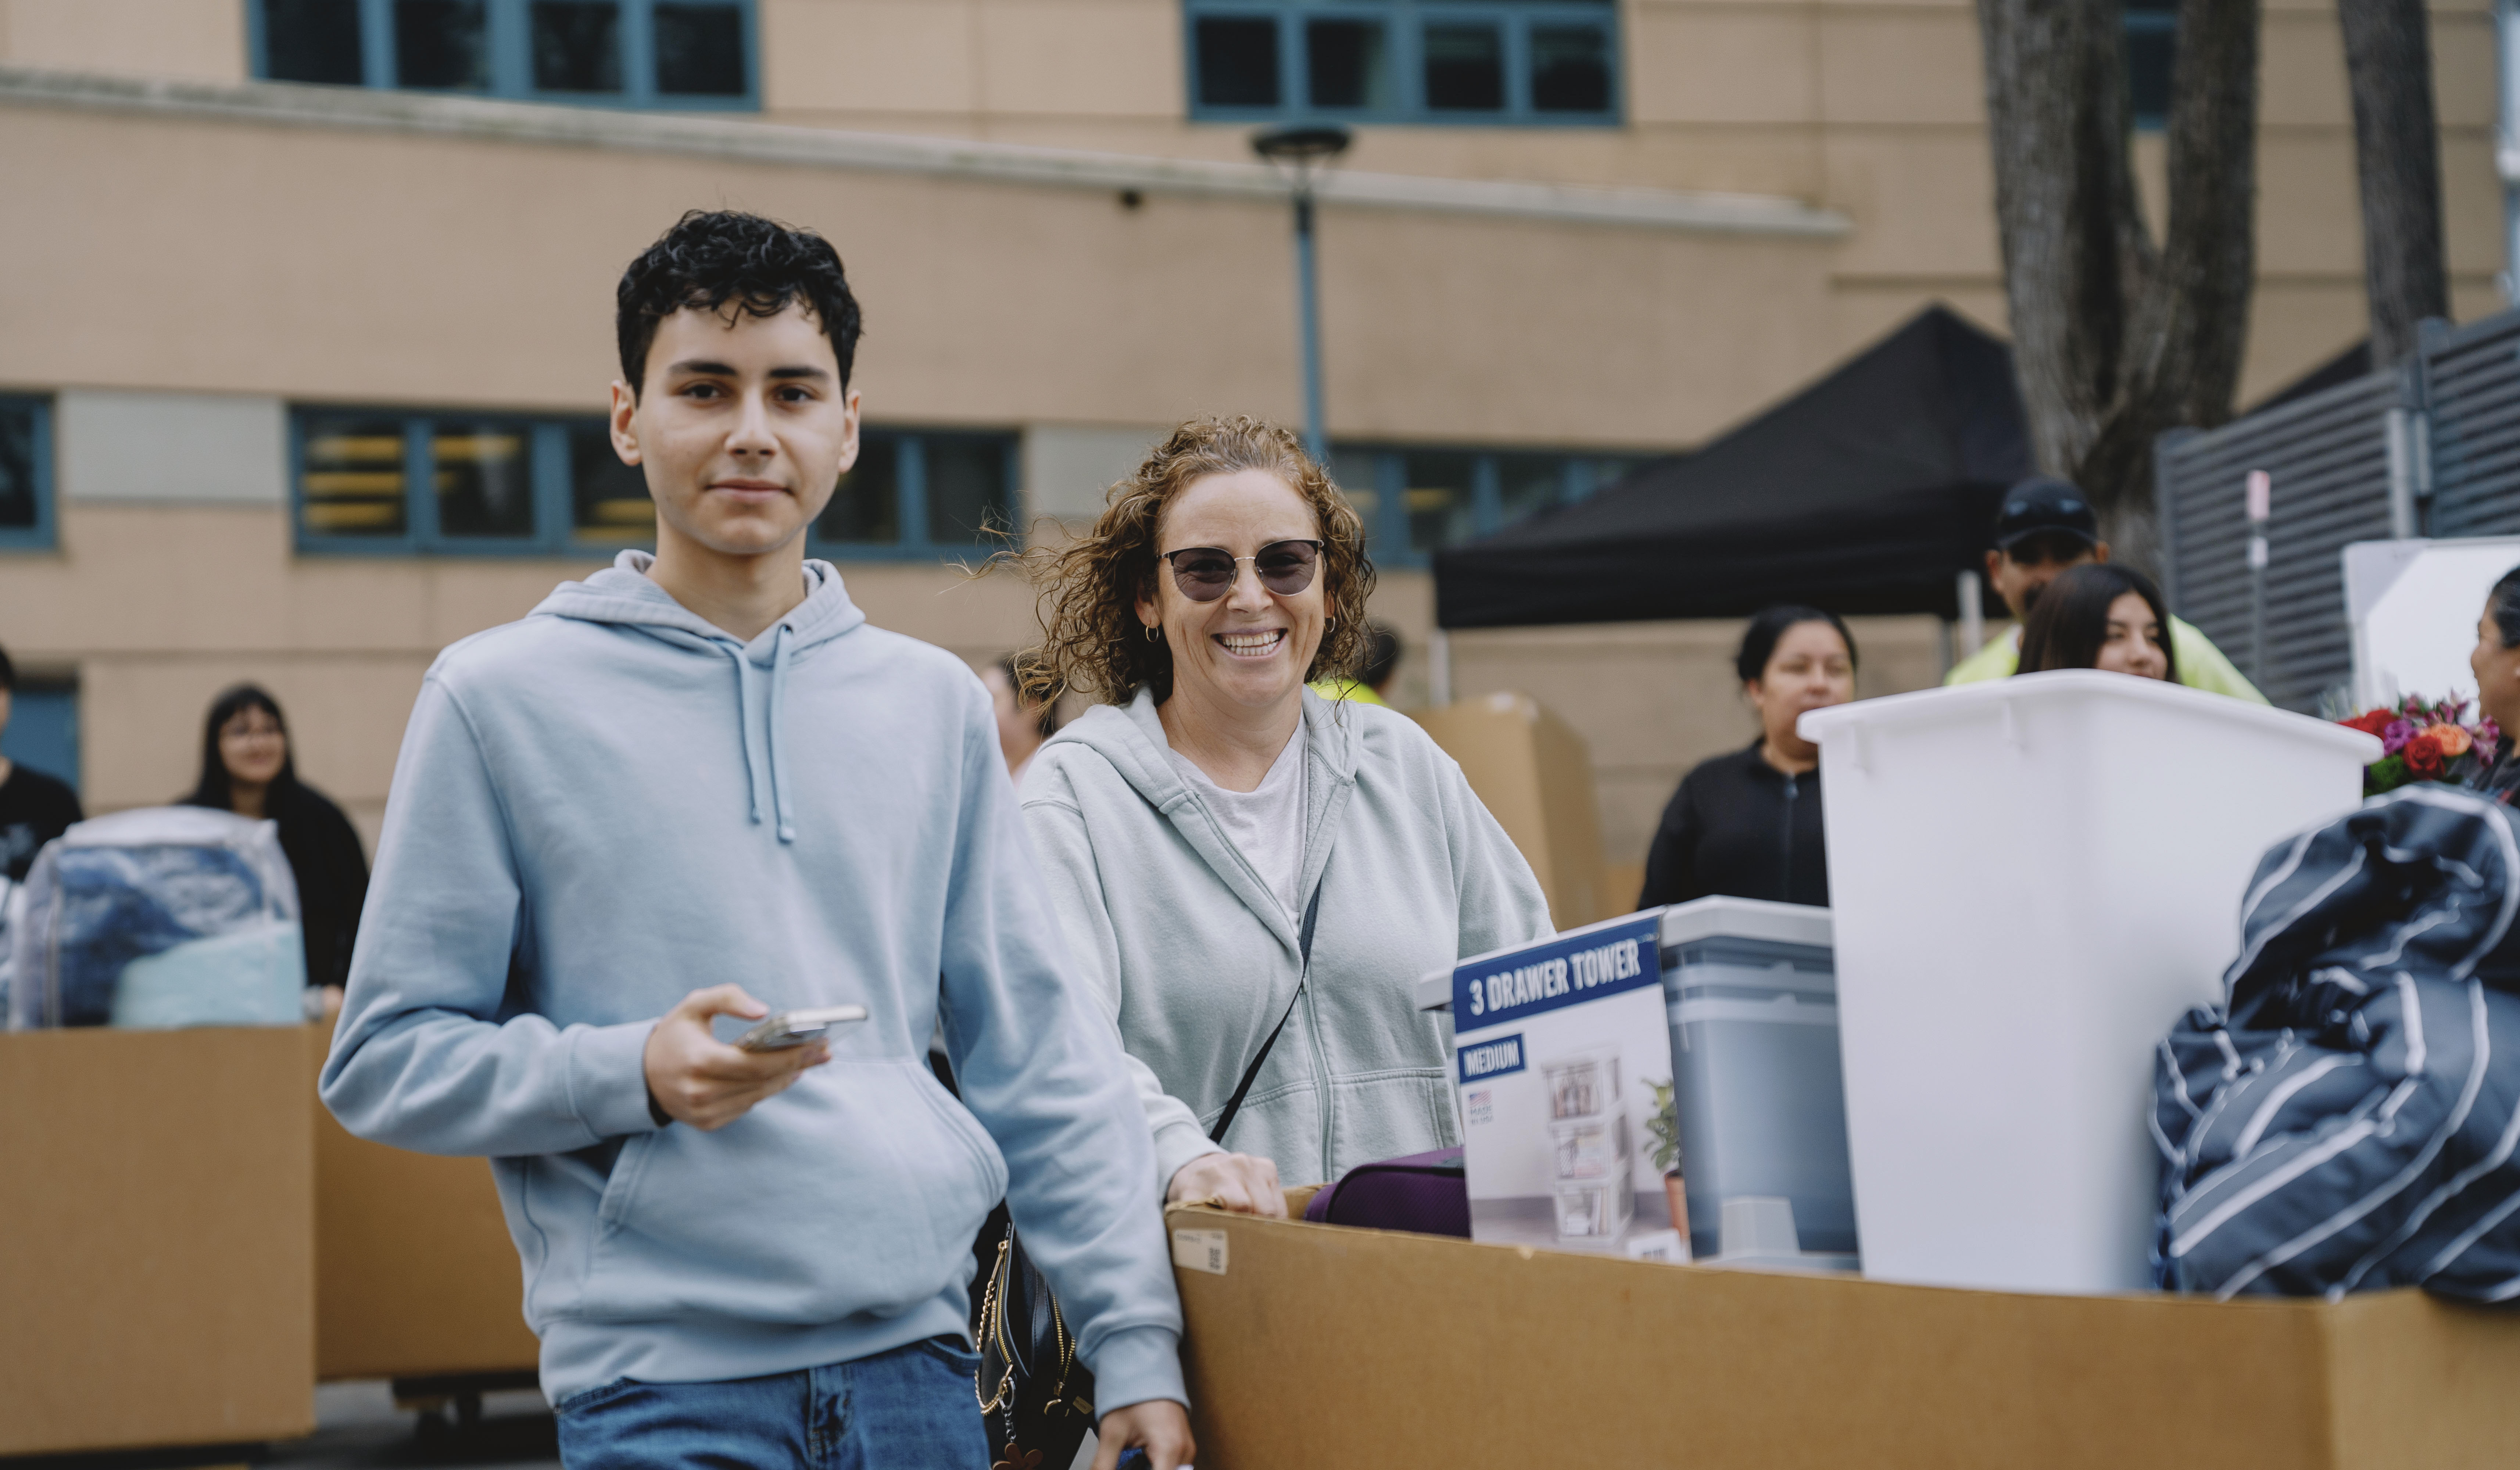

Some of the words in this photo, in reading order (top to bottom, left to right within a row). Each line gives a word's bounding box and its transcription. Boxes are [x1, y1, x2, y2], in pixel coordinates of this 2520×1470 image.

[1469, 979, 1484, 1016] 3
[1486, 957, 1570, 1012] DRAWER
[1569, 938, 1641, 990] TOWER
[1463, 1040, 1519, 1077] MEDIUM
